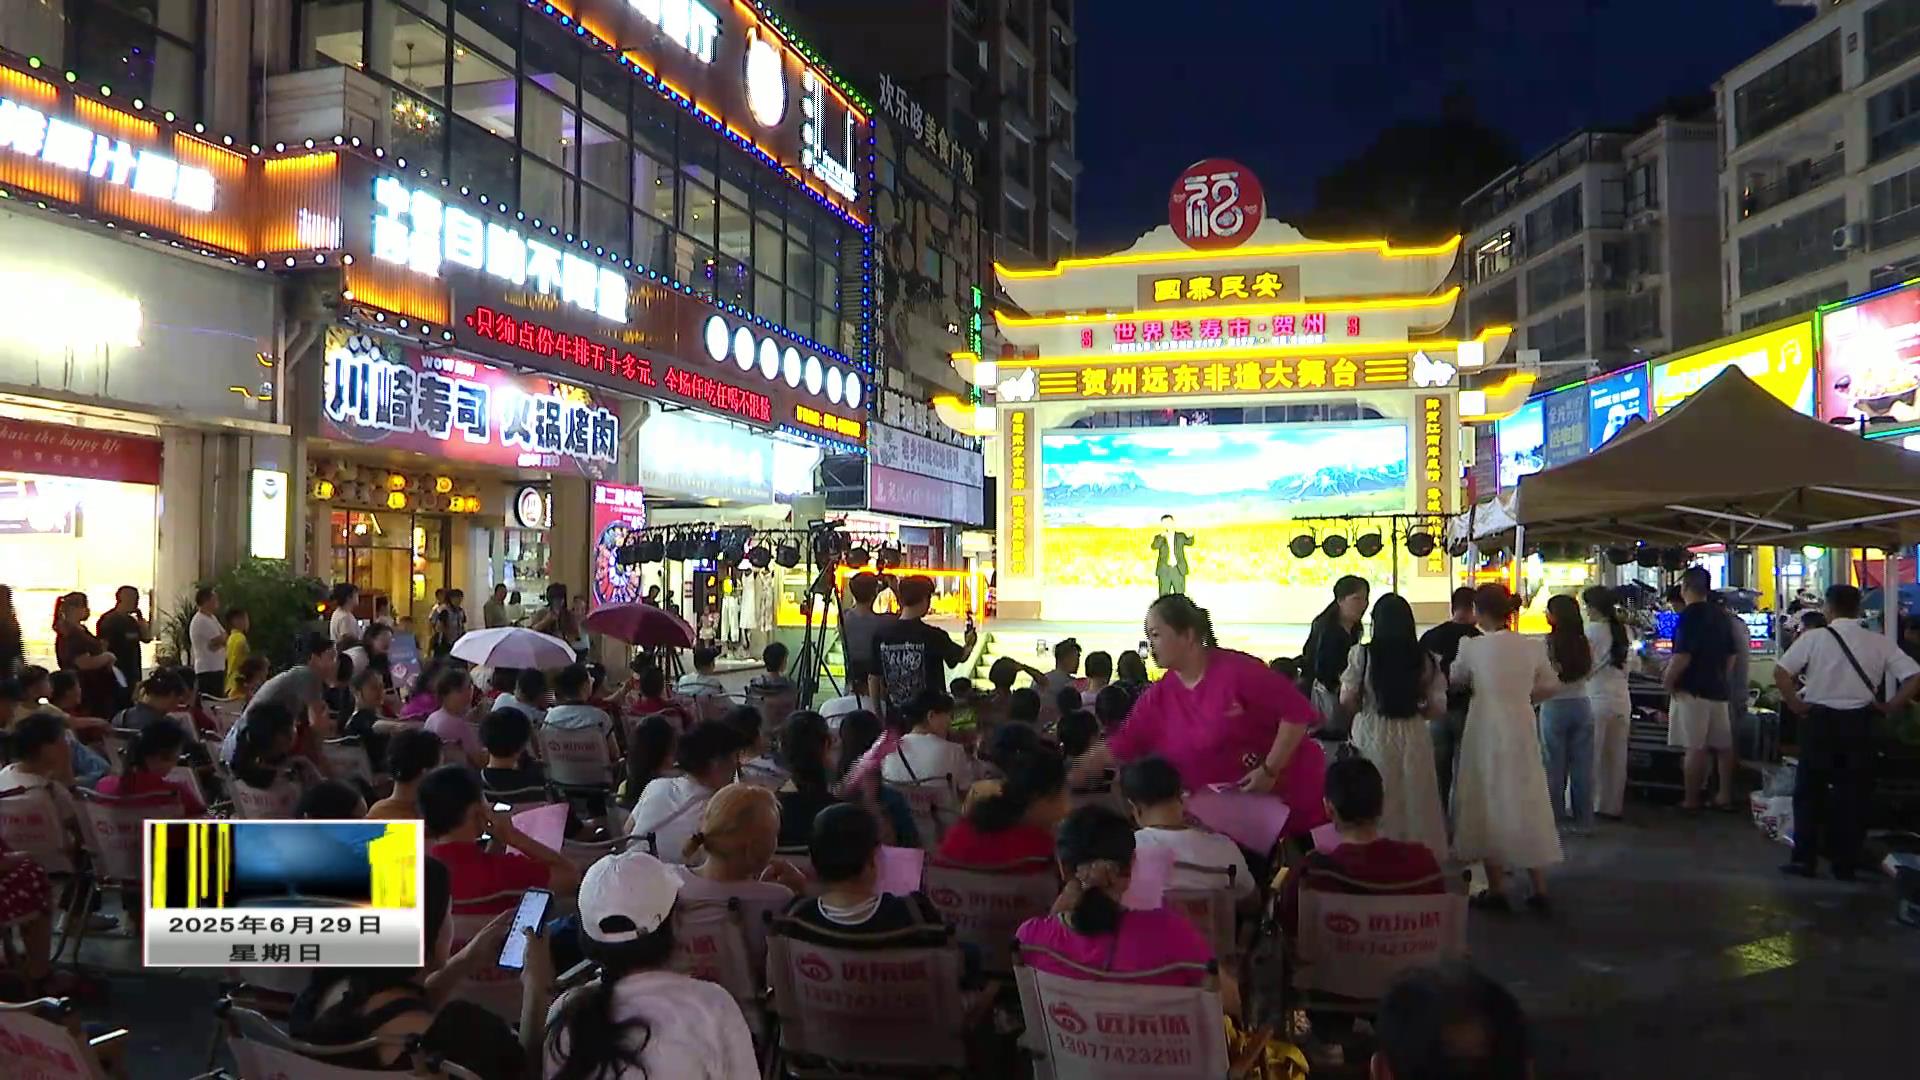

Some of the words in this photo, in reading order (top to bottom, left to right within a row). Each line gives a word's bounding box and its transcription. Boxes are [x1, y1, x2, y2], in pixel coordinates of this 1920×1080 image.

[879, 72, 974, 185] 欢乐哆美食广场
[327, 353, 489, 442] 川崎寿司
[501, 386, 618, 462] 火锅烤肉
[1082, 358, 1359, 396] 贺州远东非遗大舞台
[60, 430, 98, 453] happy
